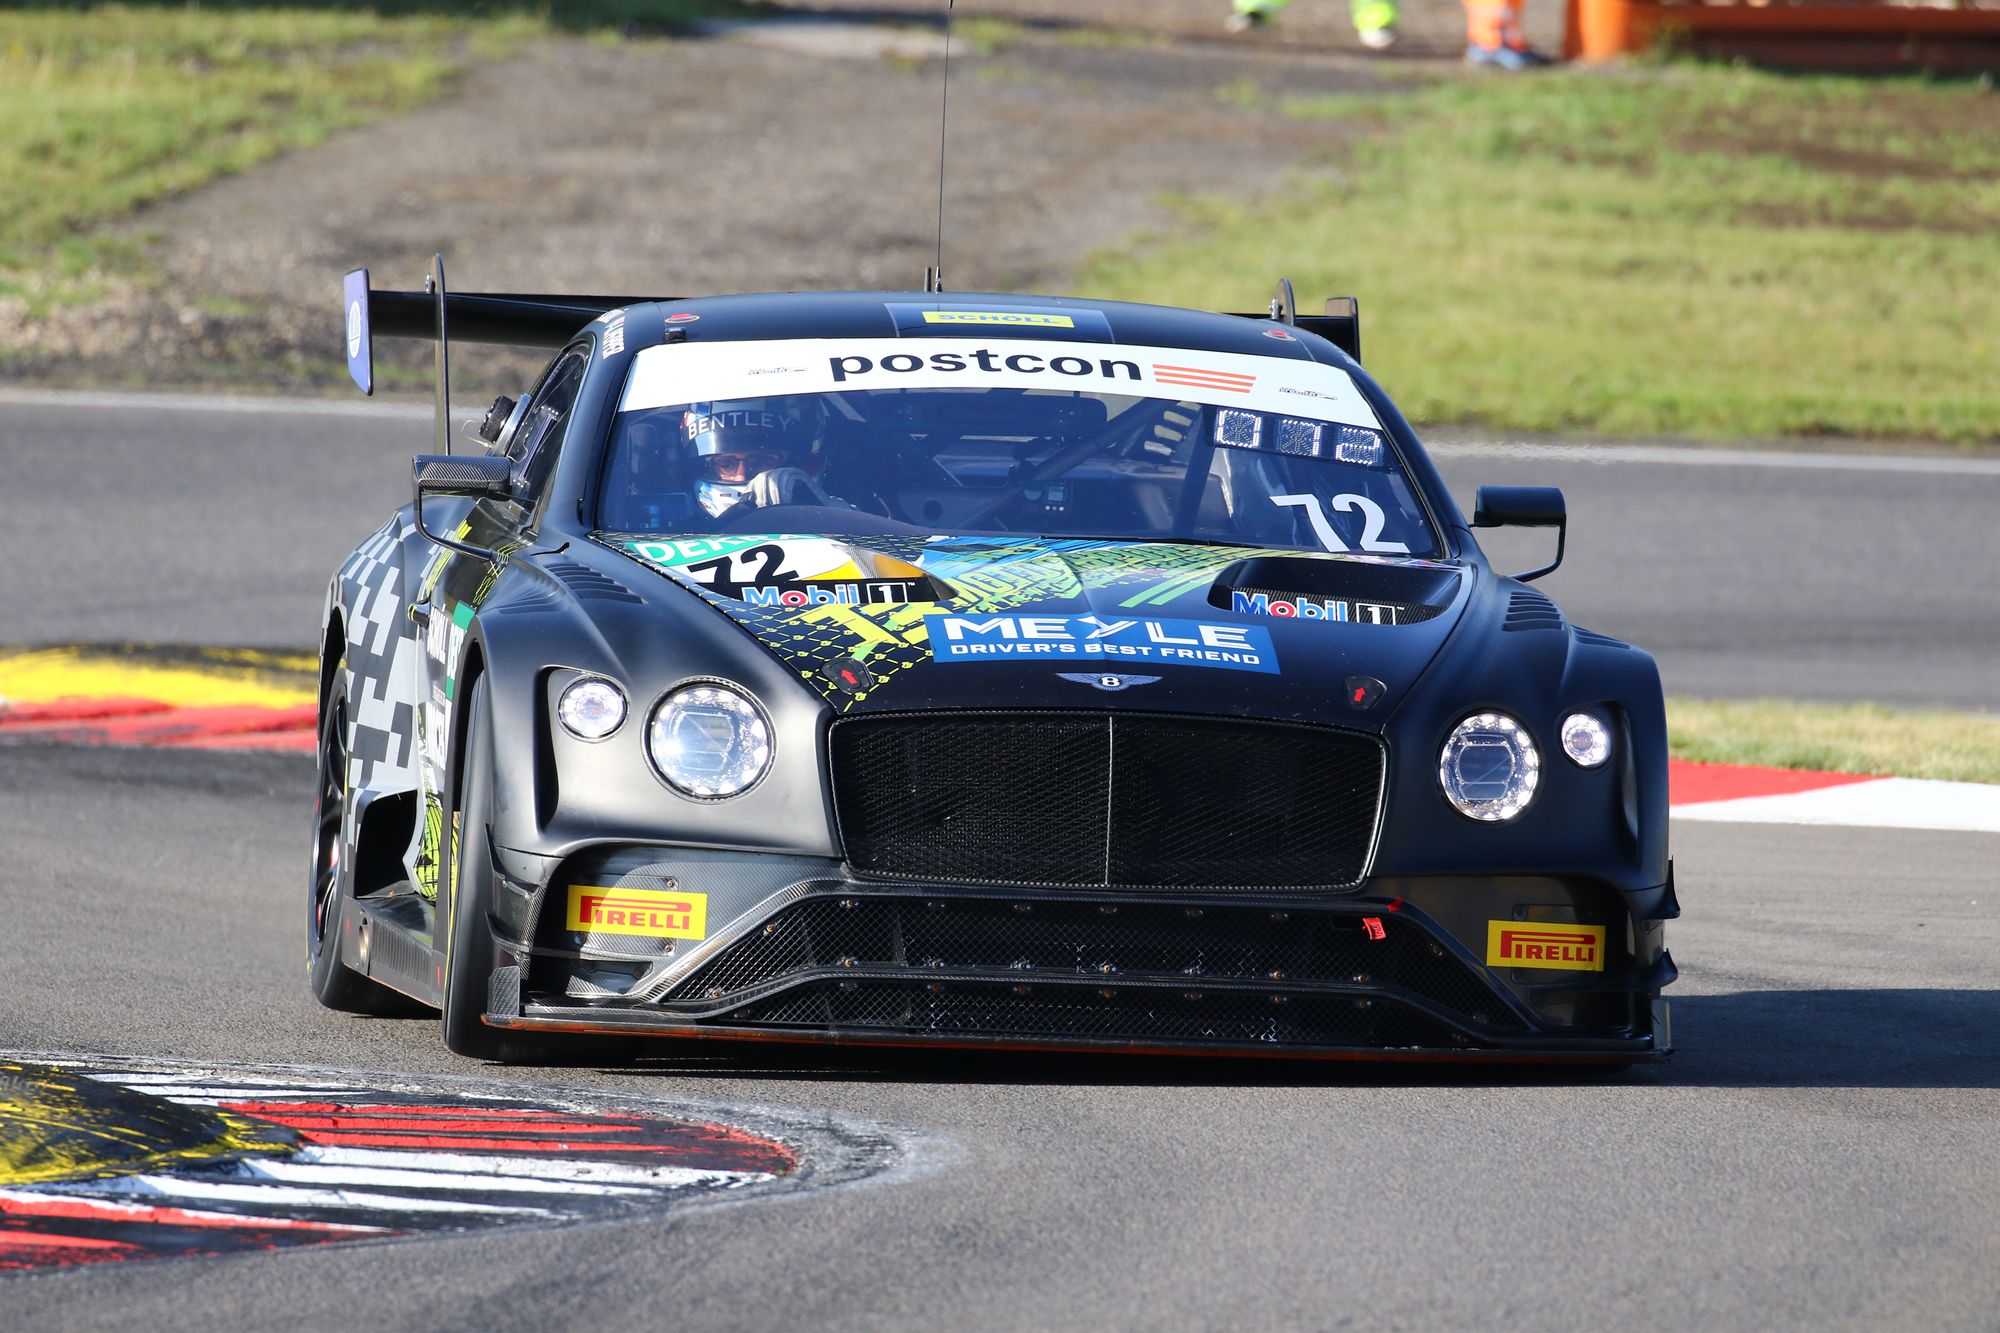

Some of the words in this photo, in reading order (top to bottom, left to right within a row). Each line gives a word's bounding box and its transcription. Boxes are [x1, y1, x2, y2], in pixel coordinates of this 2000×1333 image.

[829, 349, 1143, 383] postcon
[688, 411, 791, 440] BENTLEY
[1269, 493, 1410, 553] 72
[687, 544, 799, 584] 72
[741, 583, 861, 607] Mobil
[1232, 591, 1348, 622] Mobil
[943, 615, 1256, 650] MEYLE
[950, 643, 1076, 655] DRIVER'S
[1084, 643, 1153, 656] BEST
[1160, 647, 1260, 665] FRIEND
[1101, 676, 1121, 687] B
[579, 895, 692, 930] PIRELLI
[1500, 930, 1596, 962] PIRELLI
